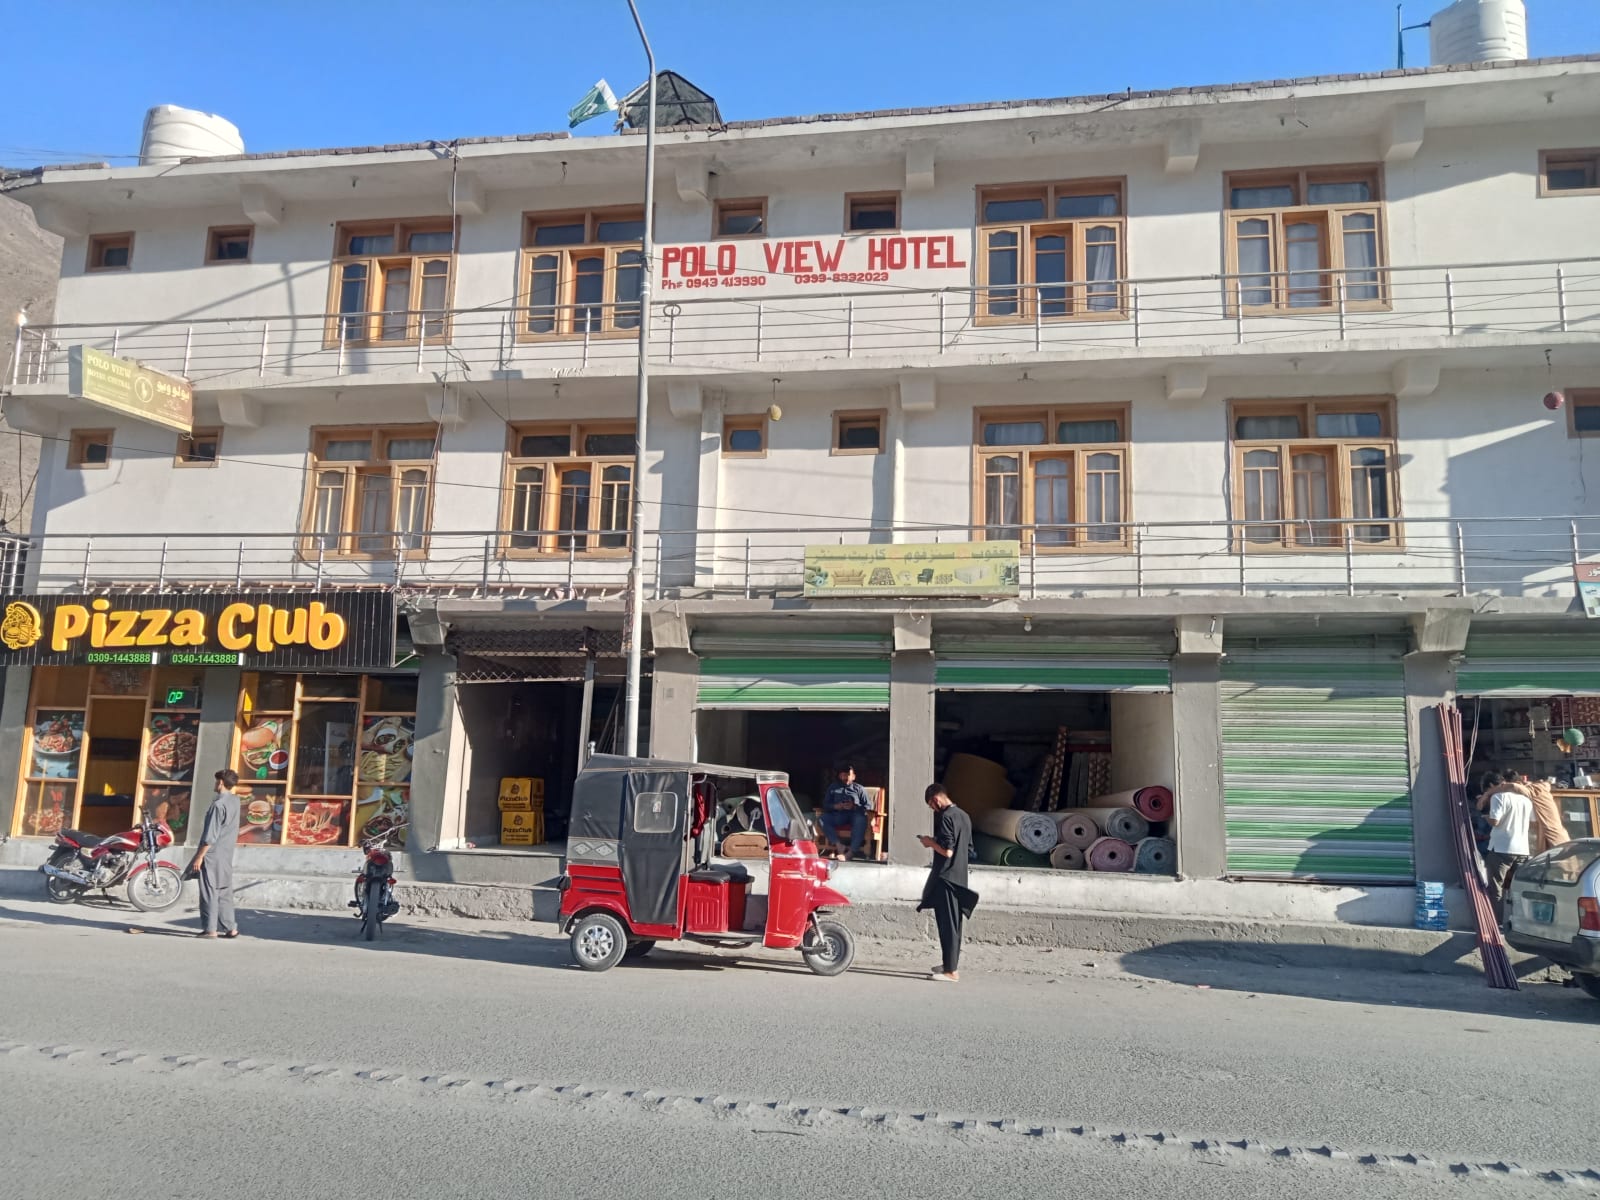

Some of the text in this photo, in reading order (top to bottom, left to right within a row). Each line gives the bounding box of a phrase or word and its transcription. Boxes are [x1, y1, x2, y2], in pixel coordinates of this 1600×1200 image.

[662, 236, 967, 278] POLO VIEW HOTEL
[686, 278, 718, 289] 0943
[87, 355, 132, 378] POLO VIEW
[51, 598, 346, 653] Pizza Club
[87, 653, 237, 664] 0309-1443888 0340-1443888
